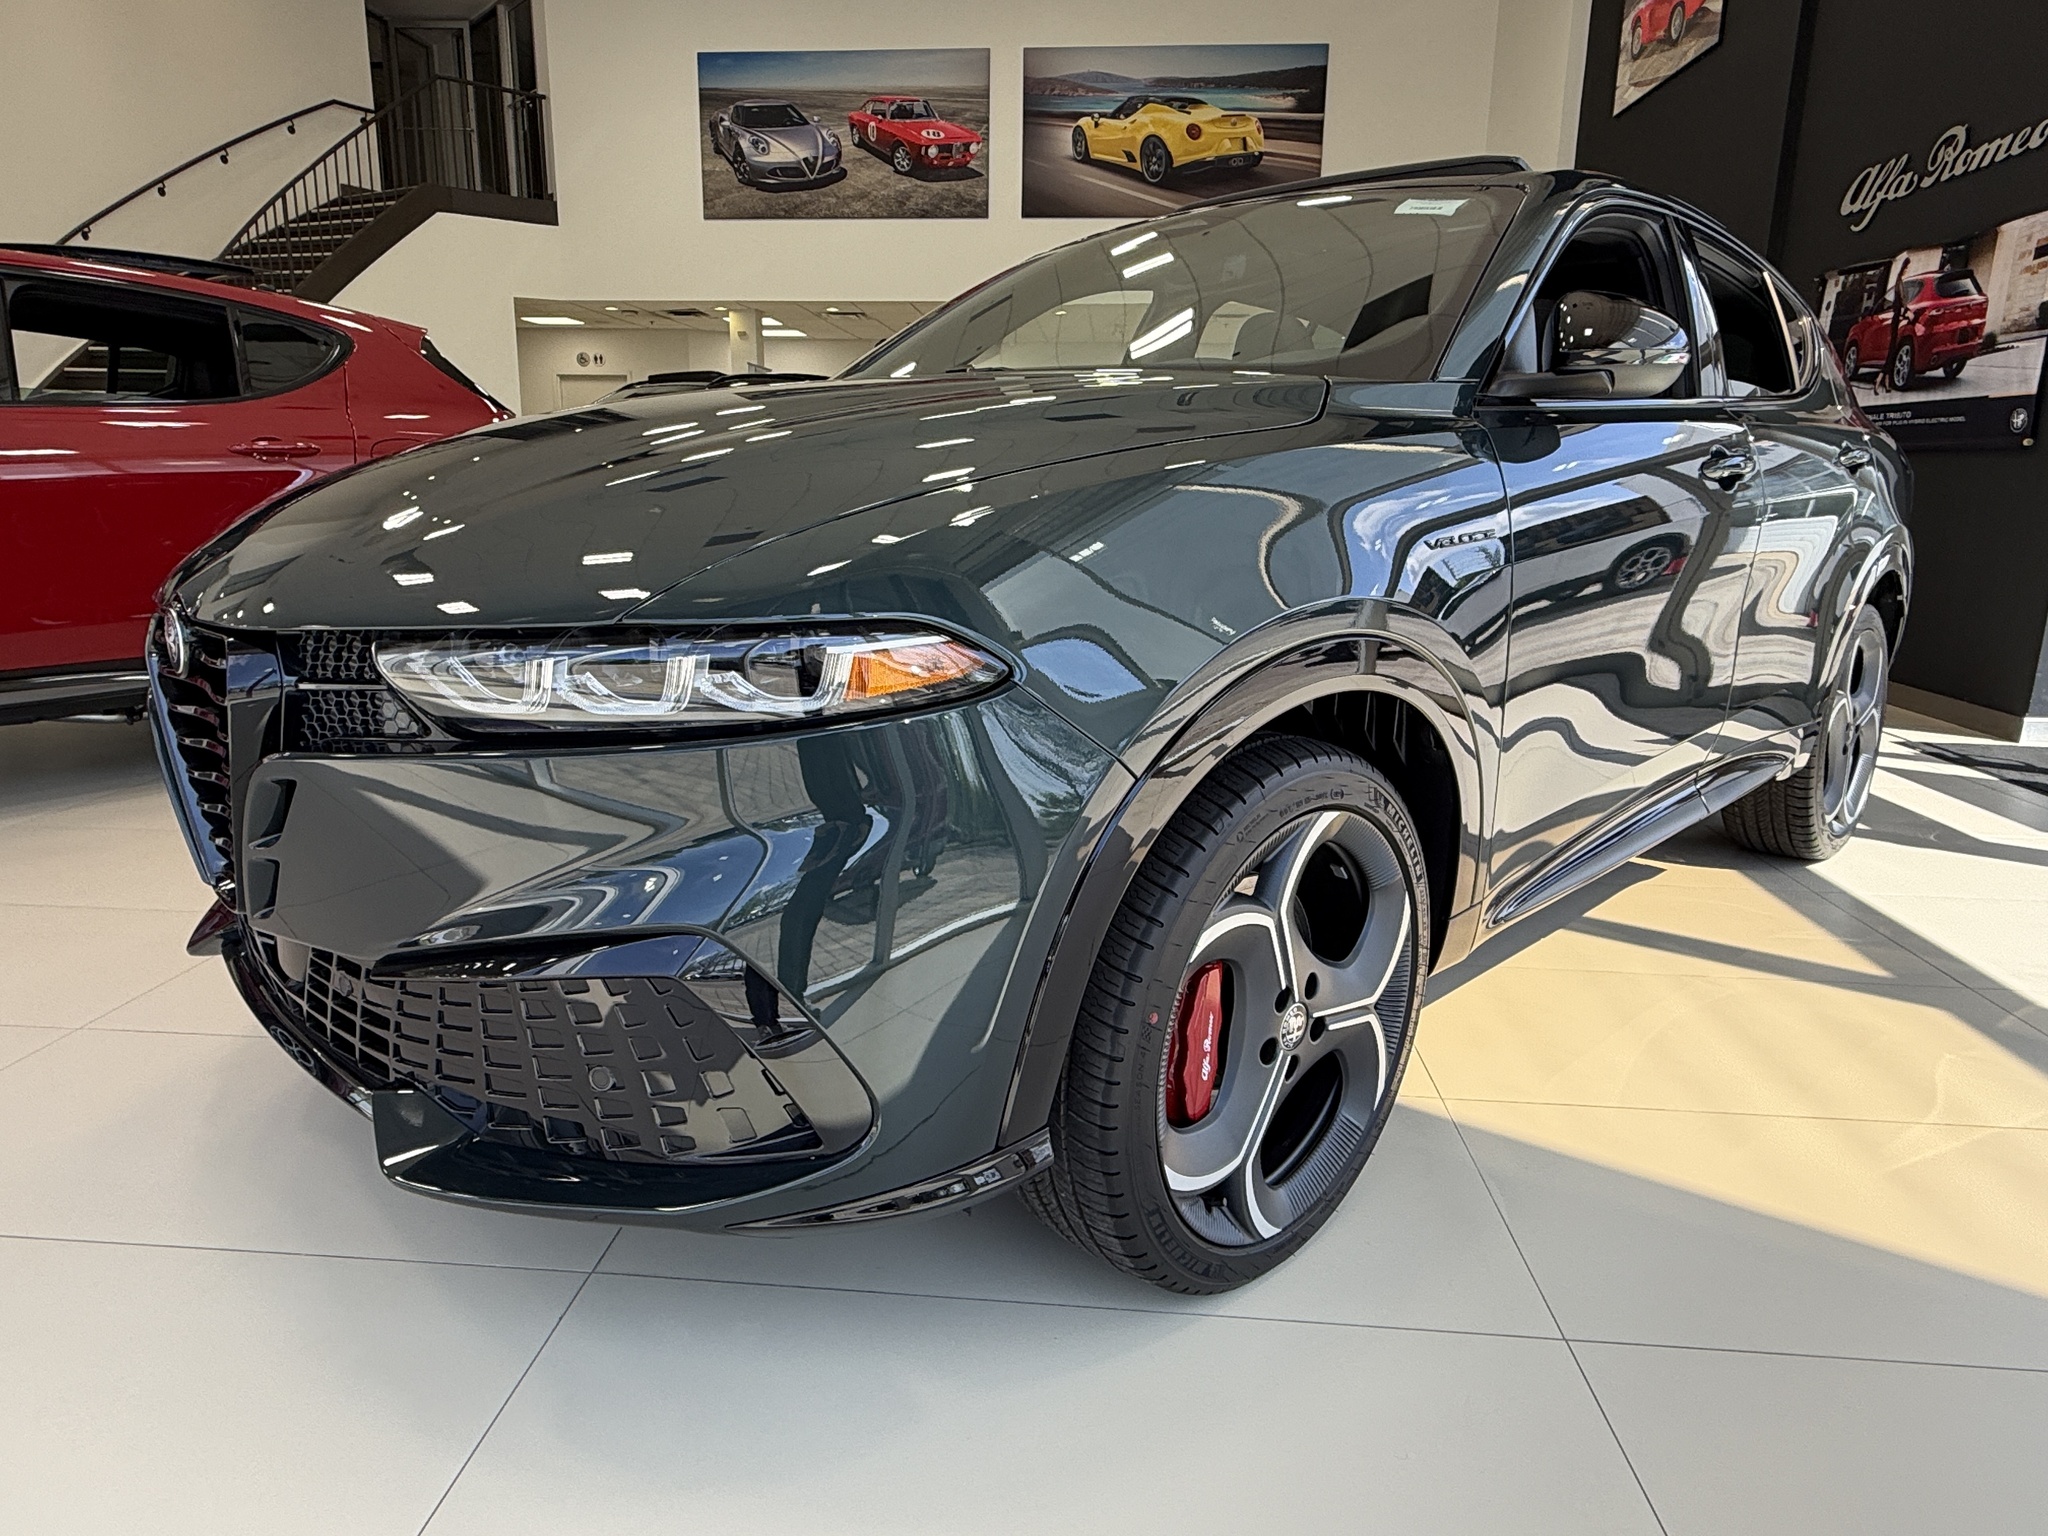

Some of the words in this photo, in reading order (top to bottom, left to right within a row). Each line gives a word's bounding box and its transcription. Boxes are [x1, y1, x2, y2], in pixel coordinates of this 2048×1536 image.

[1840, 153, 1918, 232] Alfa
[1919, 118, 2048, 188] Romeo
[1386, 803, 1423, 881] MICHELIN
[1201, 1053, 1211, 1081] Alfa
[1147, 1209, 1208, 1277] MICHELIN
